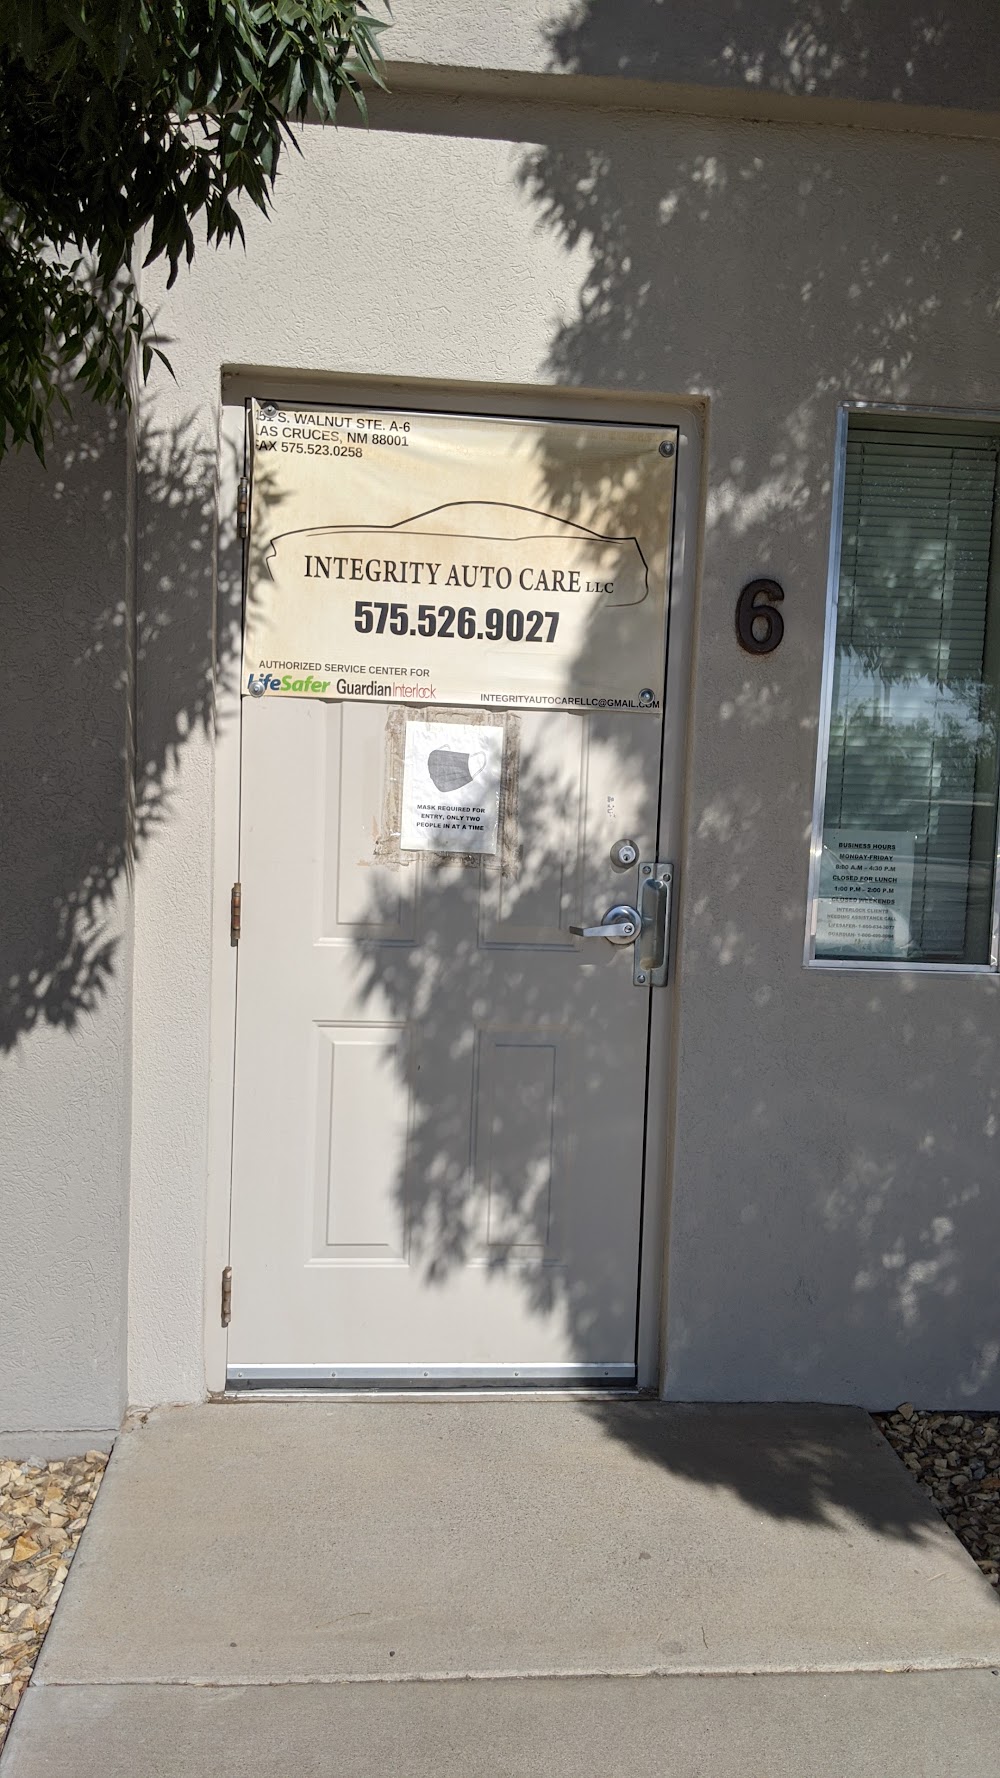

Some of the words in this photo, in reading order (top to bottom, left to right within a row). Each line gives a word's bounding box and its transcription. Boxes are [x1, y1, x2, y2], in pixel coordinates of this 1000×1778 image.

[256, 409, 274, 422] 15
[278, 412, 290, 423] S.
[294, 413, 352, 428] WALNUT
[356, 418, 386, 432] STE.
[390, 421, 410, 432] A-6
[256, 424, 278, 436] LAS
[282, 427, 343, 444] CRUCES,
[347, 432, 368, 444] NM
[372, 434, 409, 447] 88001
[281, 442, 363, 458] 575.523.0258
[304, 555, 442, 586] INTEGRITY
[444, 564, 512, 590] AUTO
[518, 568, 582, 592] CARE
[585, 580, 614, 594] LLC
[354, 600, 560, 643] 575.526.9027
[735, 578, 784, 655] 6
[258, 660, 322, 672] AUTHORIZED
[324, 664, 366, 674] SERVICE
[368, 666, 408, 676] CENTER
[410, 668, 430, 677] FOR
